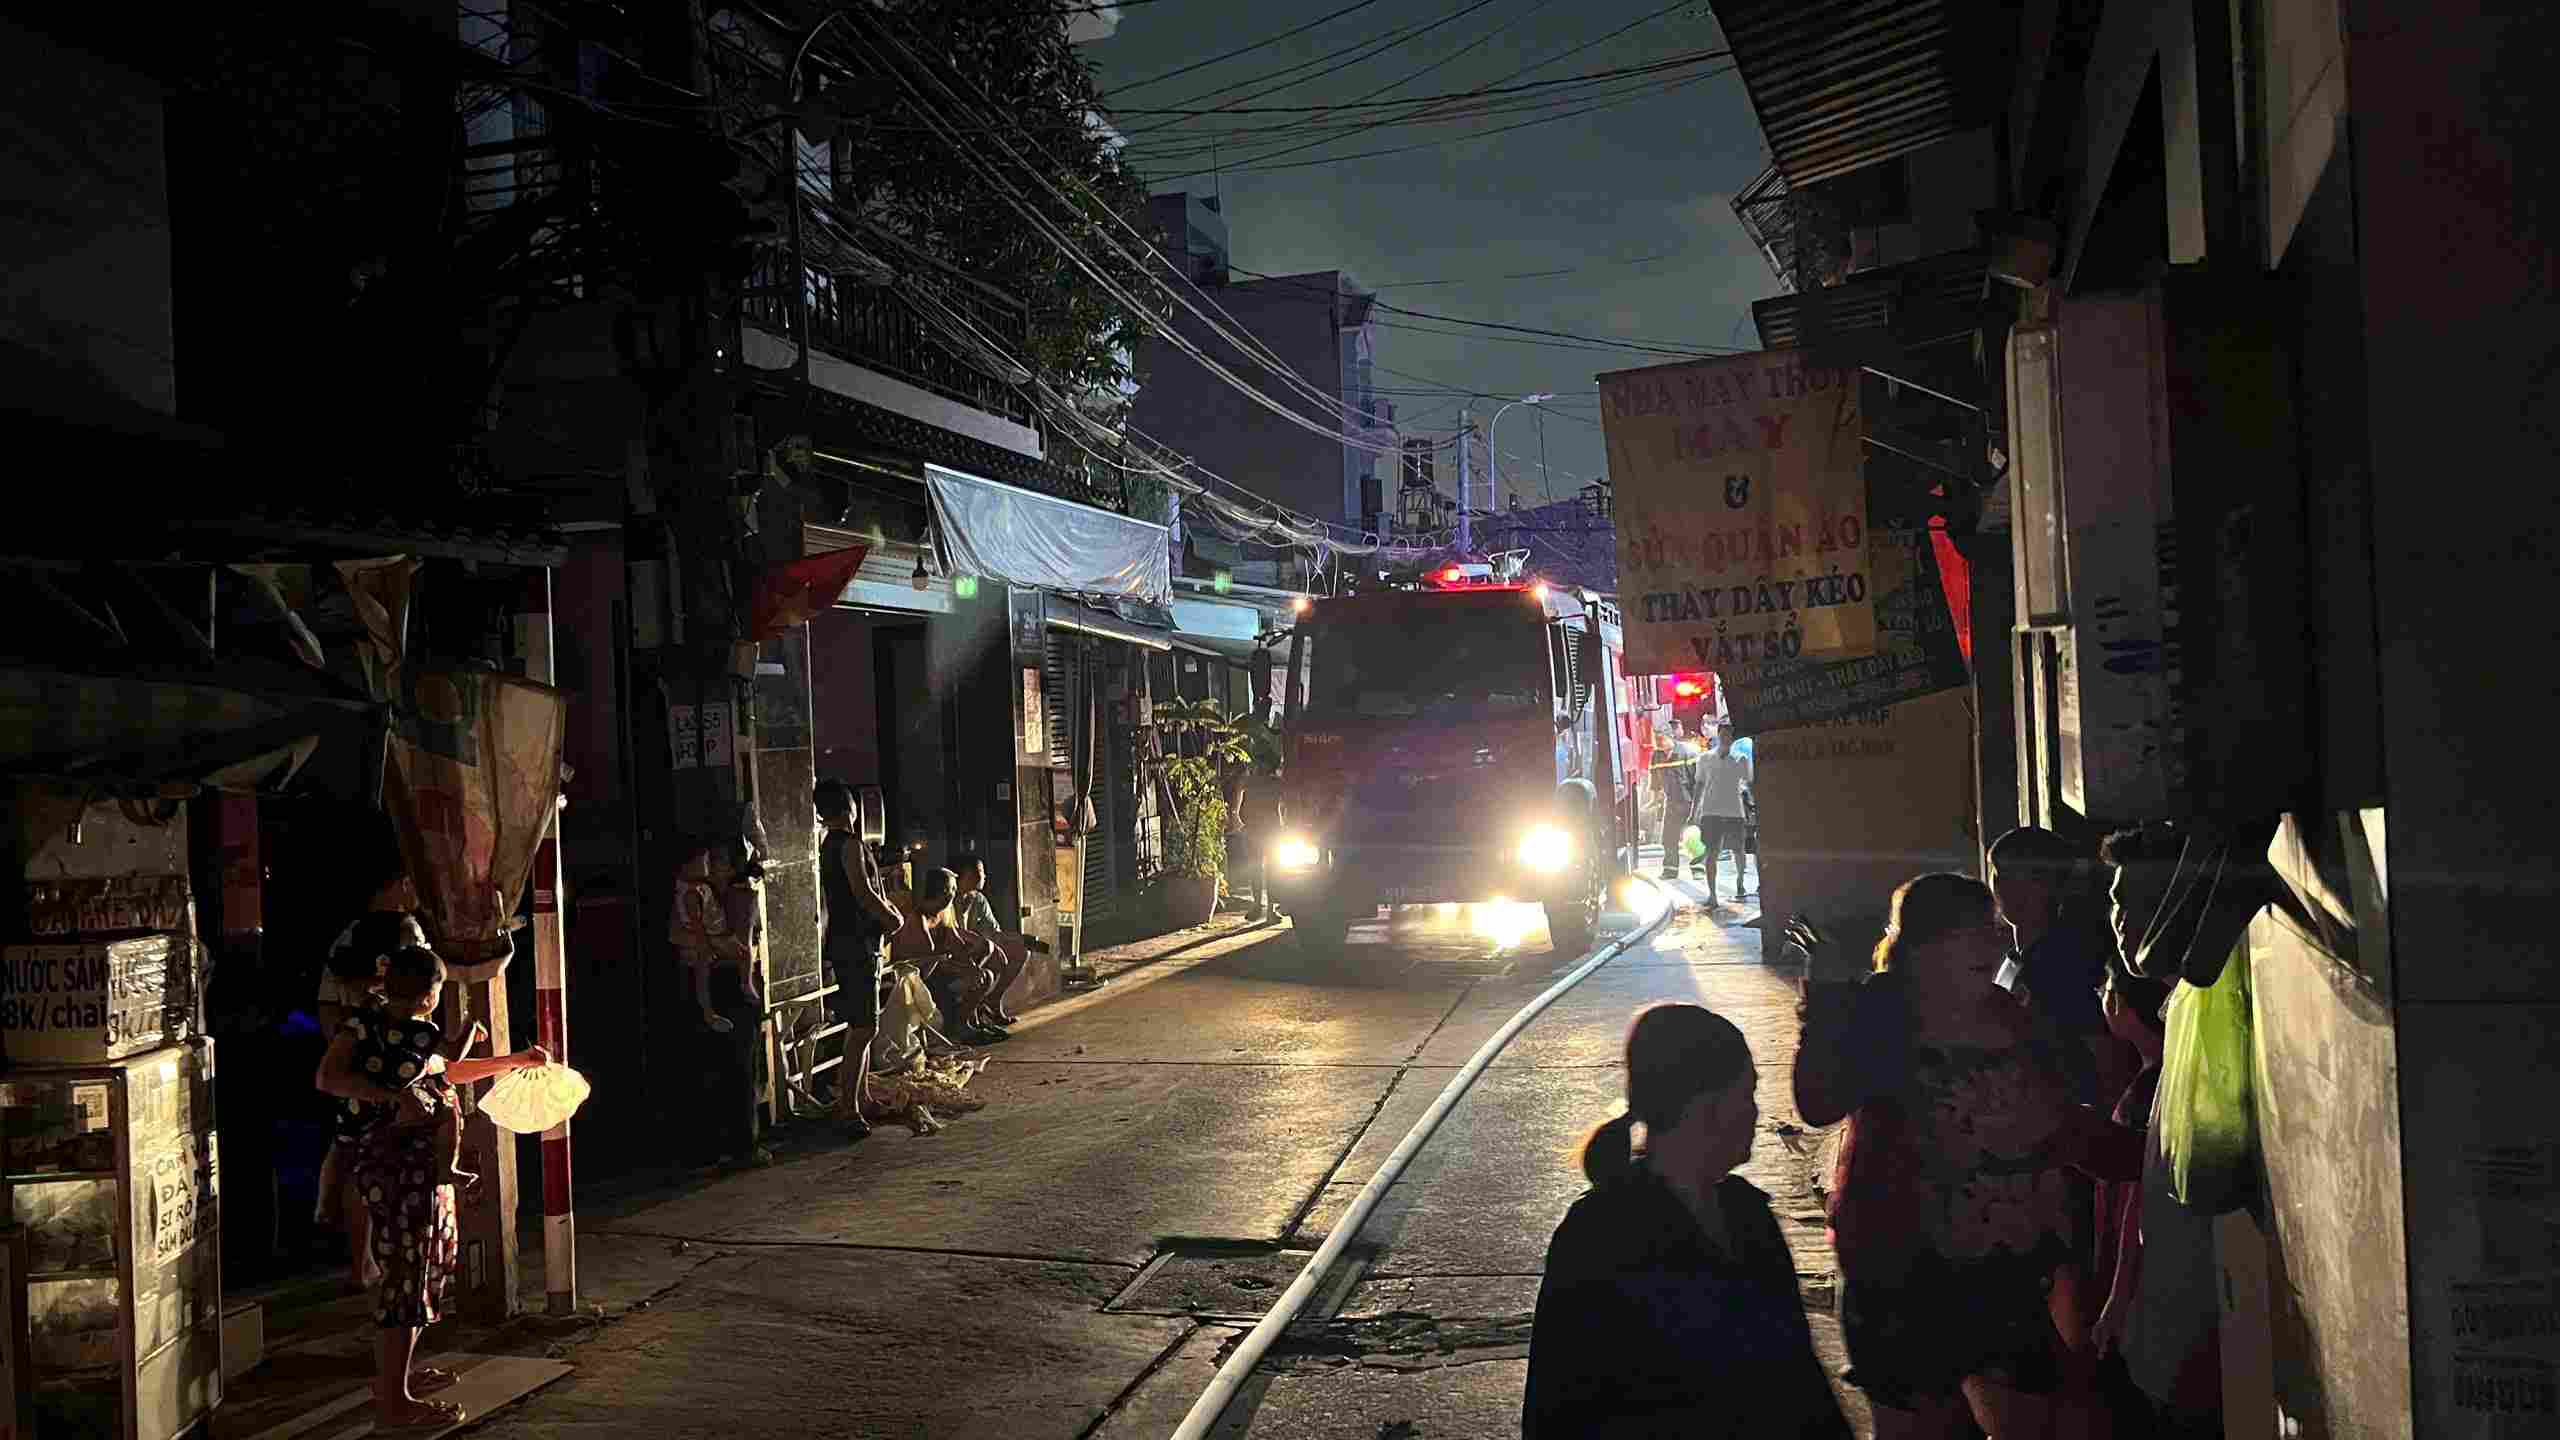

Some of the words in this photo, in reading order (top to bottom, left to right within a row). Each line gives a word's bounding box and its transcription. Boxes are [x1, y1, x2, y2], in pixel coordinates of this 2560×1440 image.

[1674, 413, 1791, 462] MAY
[1644, 586, 1721, 624] THAY
[1732, 574, 1795, 615] DÂY
[1805, 566, 1866, 609] KÉO
[1761, 611, 1801, 660] SỔ
[1, 949, 58, 992] NƯỚC
